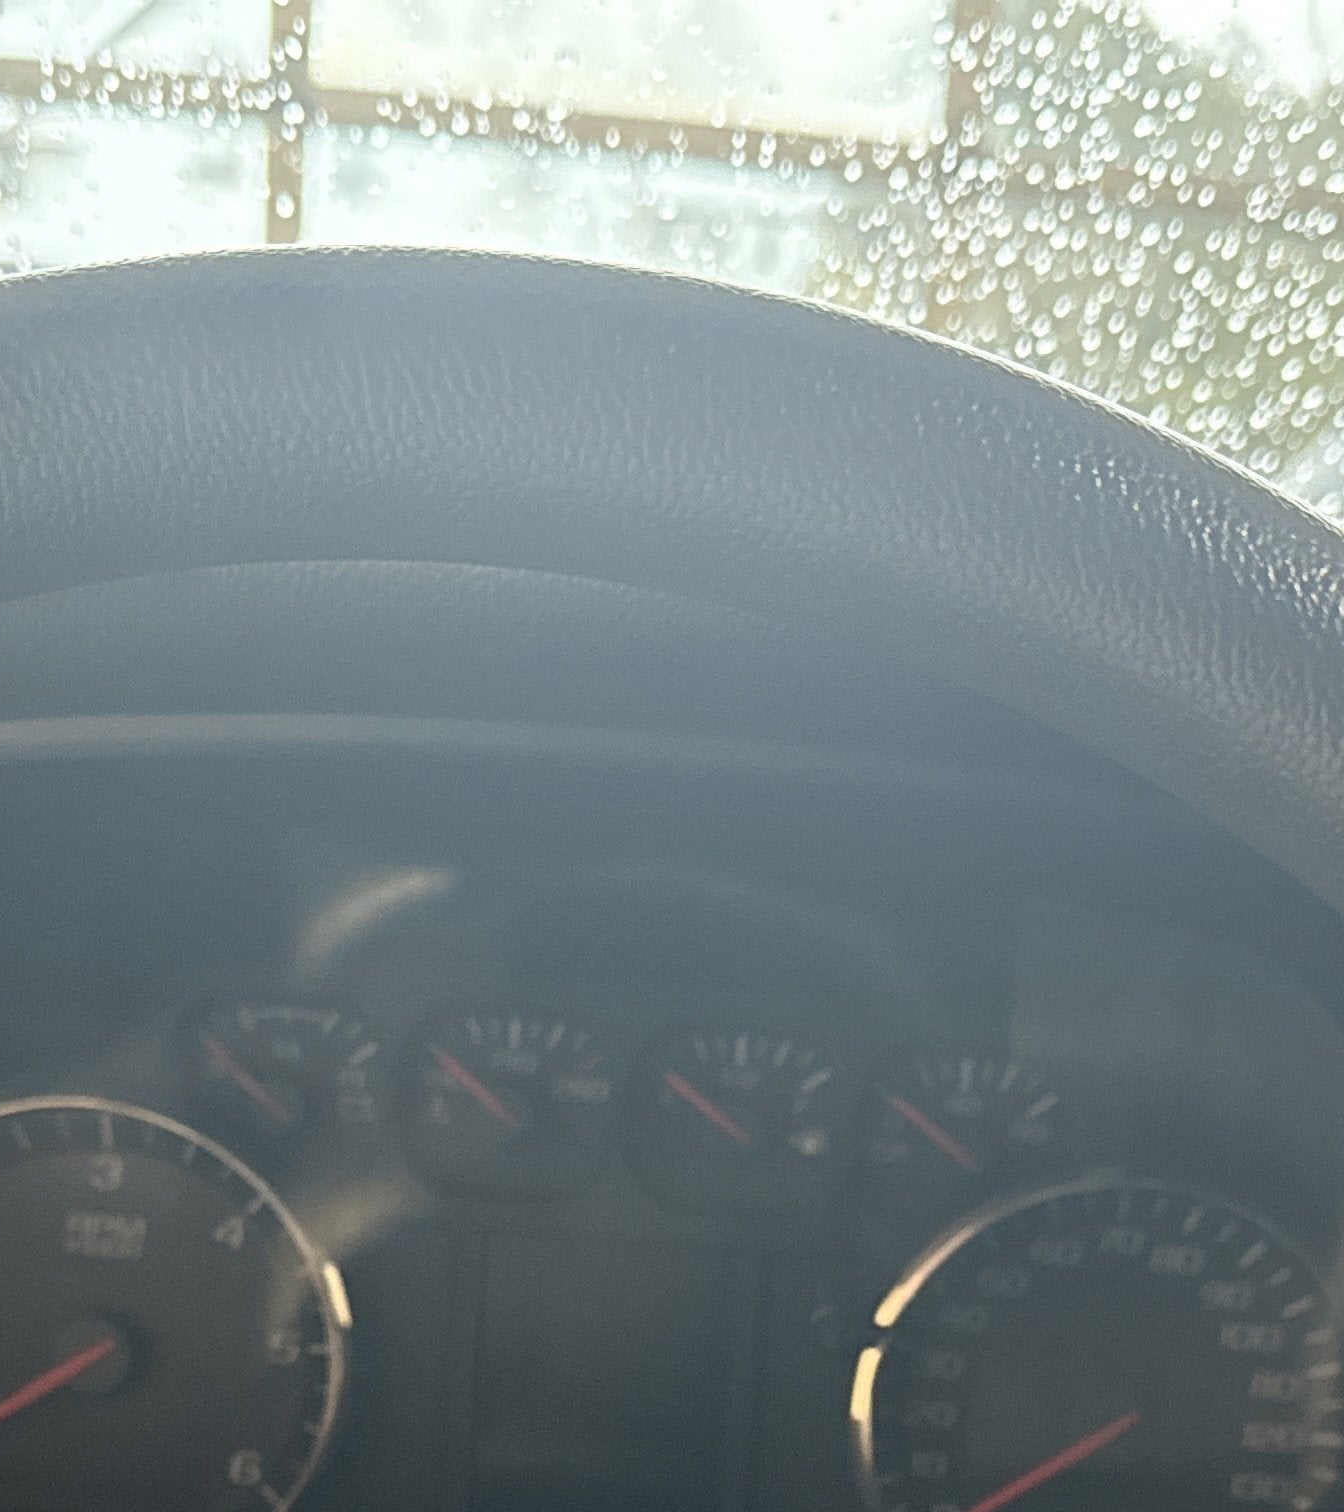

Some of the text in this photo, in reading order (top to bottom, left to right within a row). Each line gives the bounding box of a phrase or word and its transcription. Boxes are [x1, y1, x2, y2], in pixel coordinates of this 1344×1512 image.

[88, 1153, 124, 1191] 3
[212, 1215, 245, 1250] 4
[267, 1326, 300, 1365] 5
[228, 1448, 262, 1486] 6
